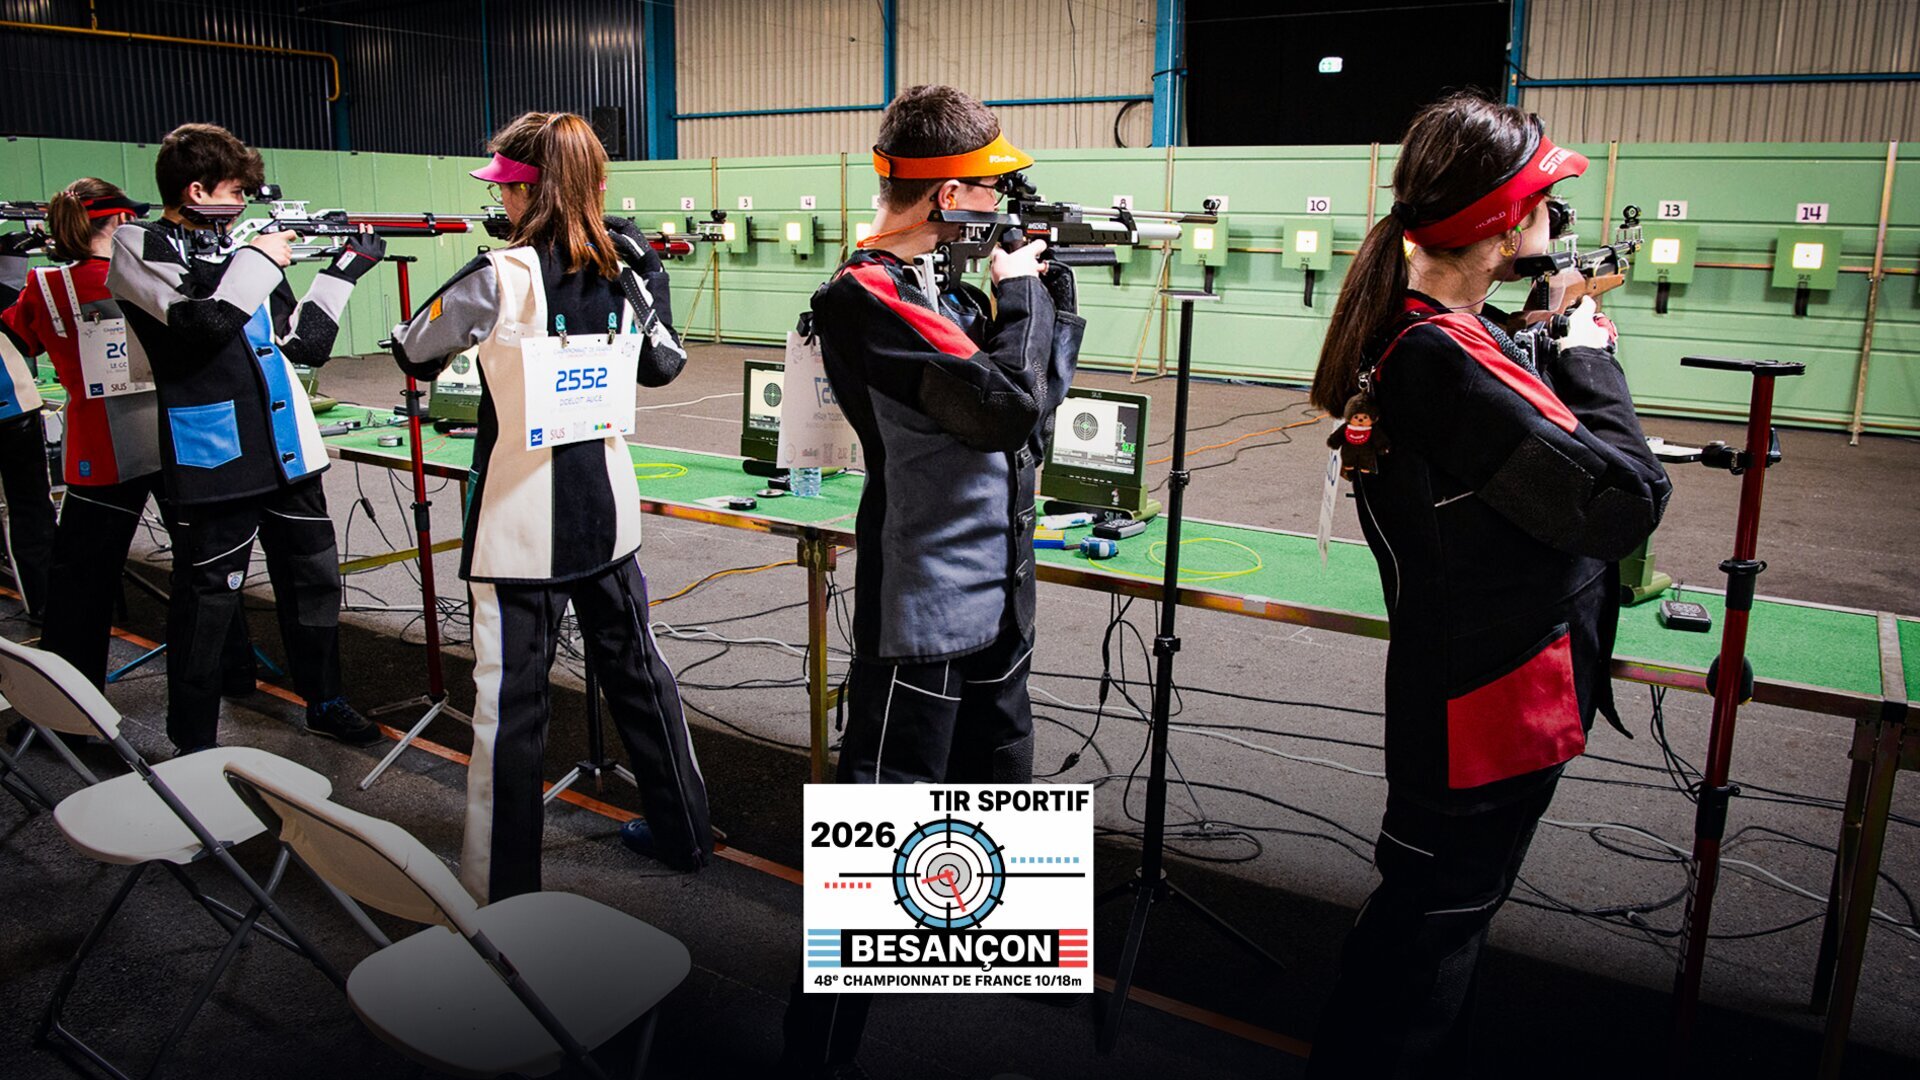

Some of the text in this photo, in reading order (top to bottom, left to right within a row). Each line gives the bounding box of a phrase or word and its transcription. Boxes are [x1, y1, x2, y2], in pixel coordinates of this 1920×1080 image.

[626, 199, 631, 209] 1
[685, 199, 692, 209] 2
[743, 198, 749, 208] 3
[805, 199, 812, 207] 4
[1310, 200, 1327, 212] 10
[1664, 204, 1681, 217] 13
[1802, 206, 1822, 221] 14
[555, 367, 608, 392] 2552
